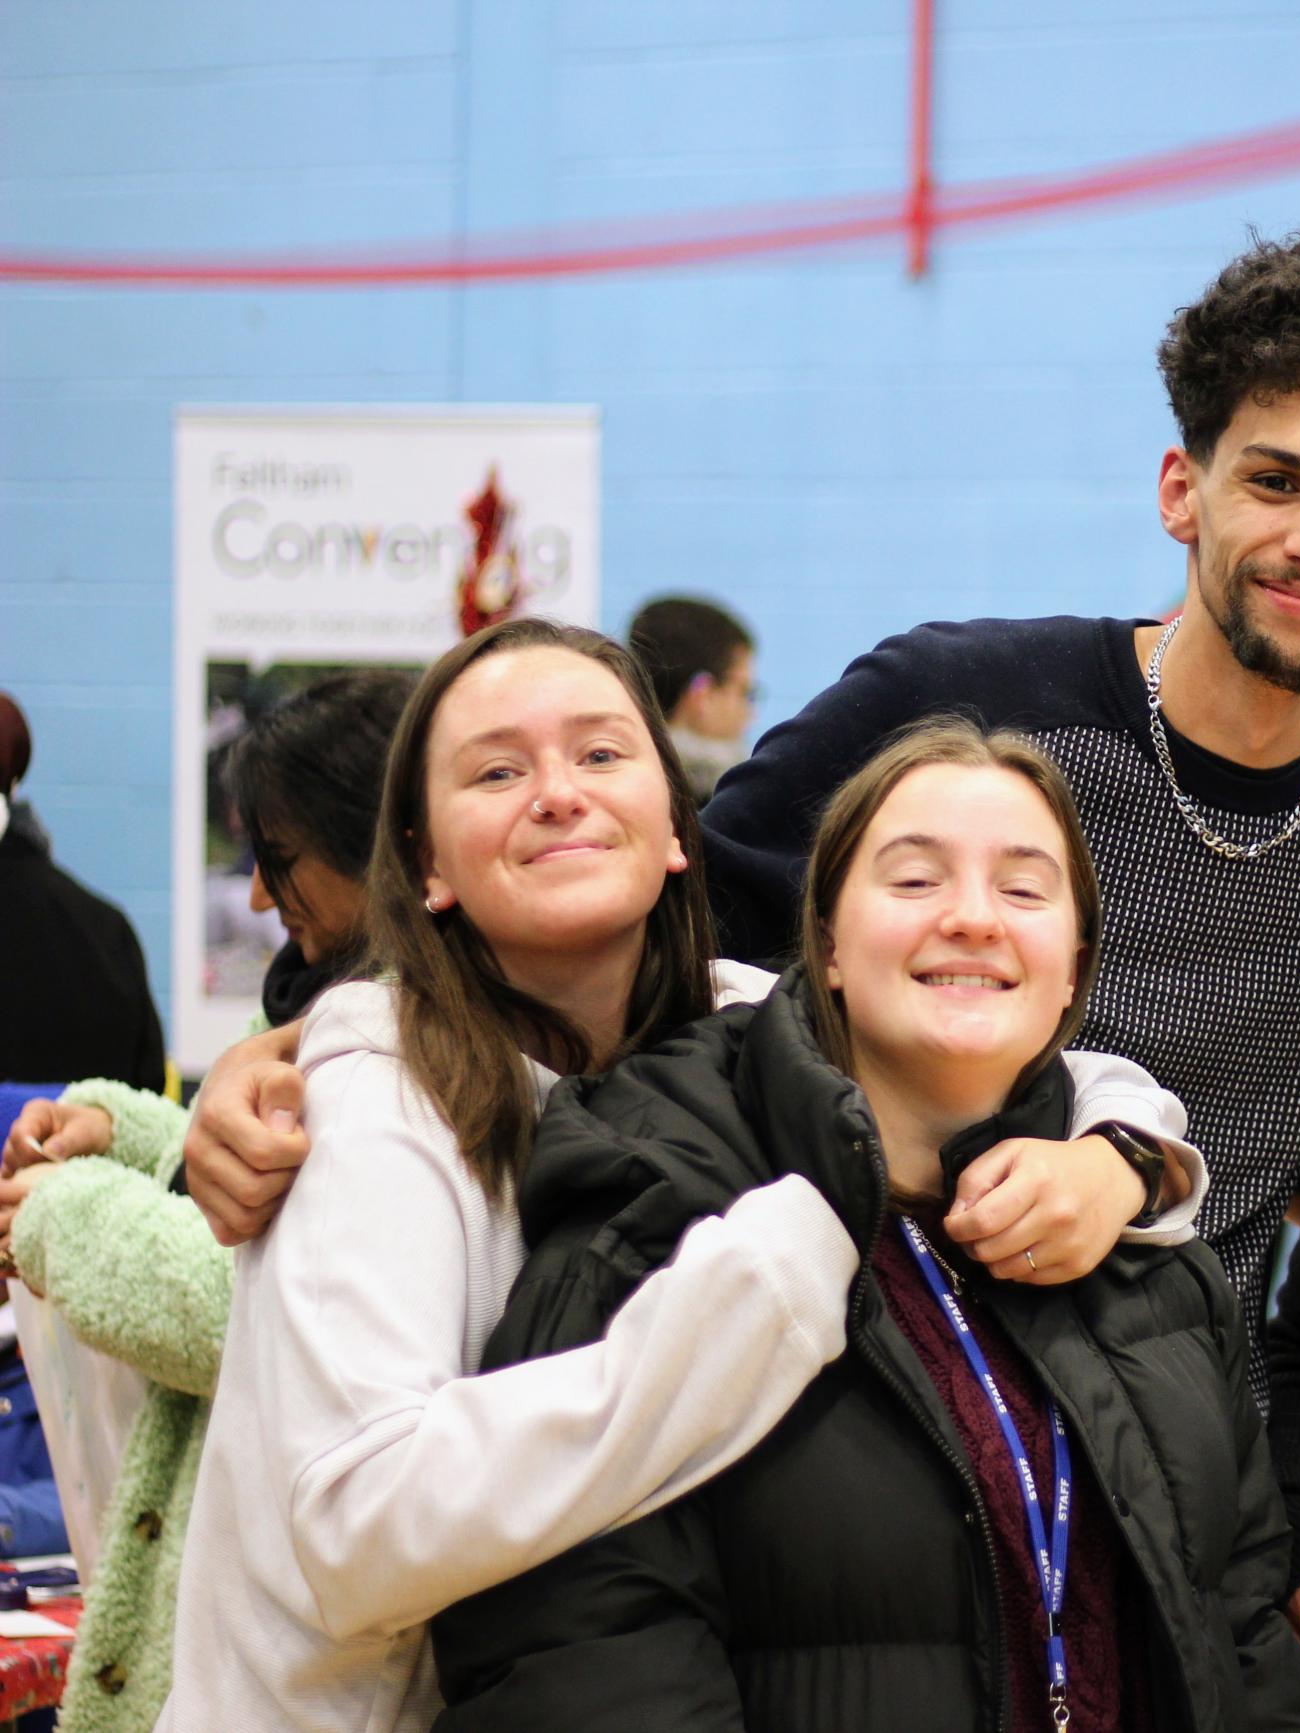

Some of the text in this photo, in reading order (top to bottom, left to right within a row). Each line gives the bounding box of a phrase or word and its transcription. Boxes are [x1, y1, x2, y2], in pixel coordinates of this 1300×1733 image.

[943, 1292, 969, 1332] STAFF
[983, 1373, 1008, 1413] STAFF
[1018, 1457, 1037, 1501] STAFF
[1058, 1478, 1069, 1522] STAFF
